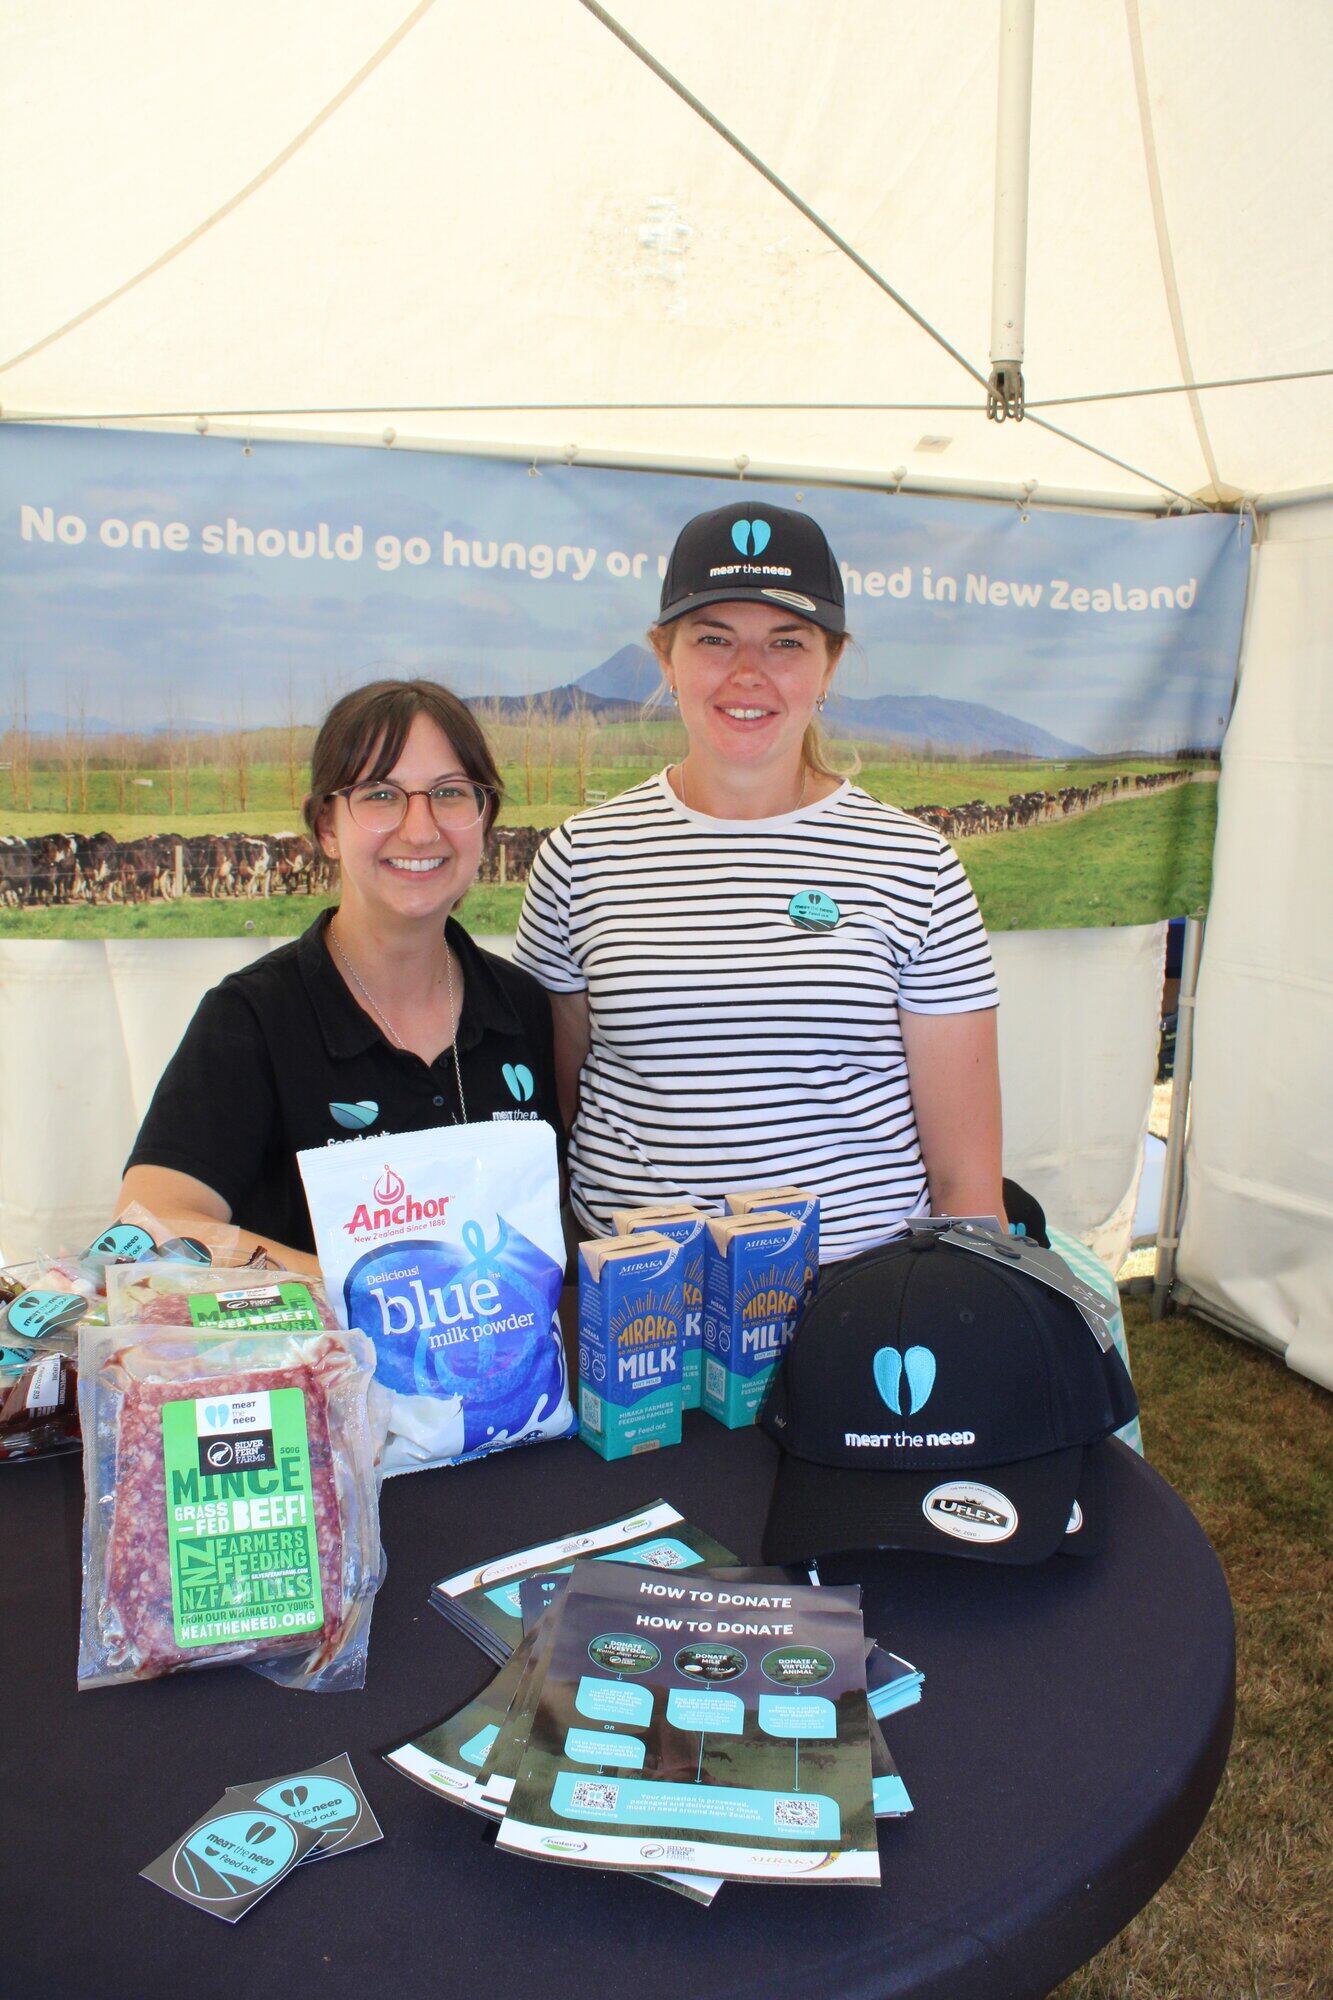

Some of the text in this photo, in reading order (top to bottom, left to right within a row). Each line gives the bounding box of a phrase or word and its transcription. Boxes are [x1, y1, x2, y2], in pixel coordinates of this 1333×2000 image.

[20, 505, 86, 544] No
[99, 518, 189, 551] one
[201, 517, 363, 561] should
[375, 534, 431, 571] go
[444, 530, 597, 581] hungry
[607, 550, 648, 578] or
[924, 566, 958, 602] in
[966, 573, 1041, 608] New
[1050, 577, 1198, 612] Zealand
[742, 564, 762, 575] the
[343, 1195, 449, 1234] Anchor
[354, 1235, 371, 1243] New
[373, 1227, 405, 1239] Zealand
[406, 1223, 428, 1232] Since
[745, 1237, 786, 1250] MIRAKA
[366, 1265, 419, 1286] Delicious!
[619, 1260, 663, 1275] MIRAKA
[370, 1275, 502, 1335] blue
[743, 1290, 797, 1320] MIRAKA
[428, 1311, 535, 1349] milk powder
[618, 1315, 677, 1348] MIRAKA
[743, 1320, 796, 1354] MILK
[618, 1346, 676, 1382] MILK
[234, 1439, 264, 1449] SILVER
[893, 1431, 924, 1448] the
[235, 1447, 260, 1457] FERN
[235, 1454, 266, 1464] FARMS
[280, 1446, 300, 1454] 500G
[172, 1456, 304, 1505] MINCE
[174, 1502, 229, 1521] GRASS
[233, 1494, 307, 1532] BEEF!
[939, 1500, 1001, 1525] UFLEX
[216, 1530, 304, 1556] FARMERS
[218, 1548, 307, 1583] FEEDING
[640, 1582, 792, 1609] HOW TO DONATE
[205, 1611, 227, 1622] OUR
[270, 1603, 285, 1613] TO
[288, 1600, 315, 1612] YOURS
[181, 1610, 316, 1641] MEATTHENEED.ORG
[636, 1615, 793, 1636] HOW TO DONATE
[604, 1644, 646, 1654] LIVESTOCK
[610, 1640, 642, 1650] DONATE
[292, 1806, 311, 1818] the
[320, 1809, 338, 1821] out
[233, 1844, 251, 1859] the
[547, 1838, 583, 1849] Fonterra
[666, 1844, 695, 1852] SILVER
[241, 1862, 259, 1875] out
[750, 1855, 816, 1865] MIRAKA
